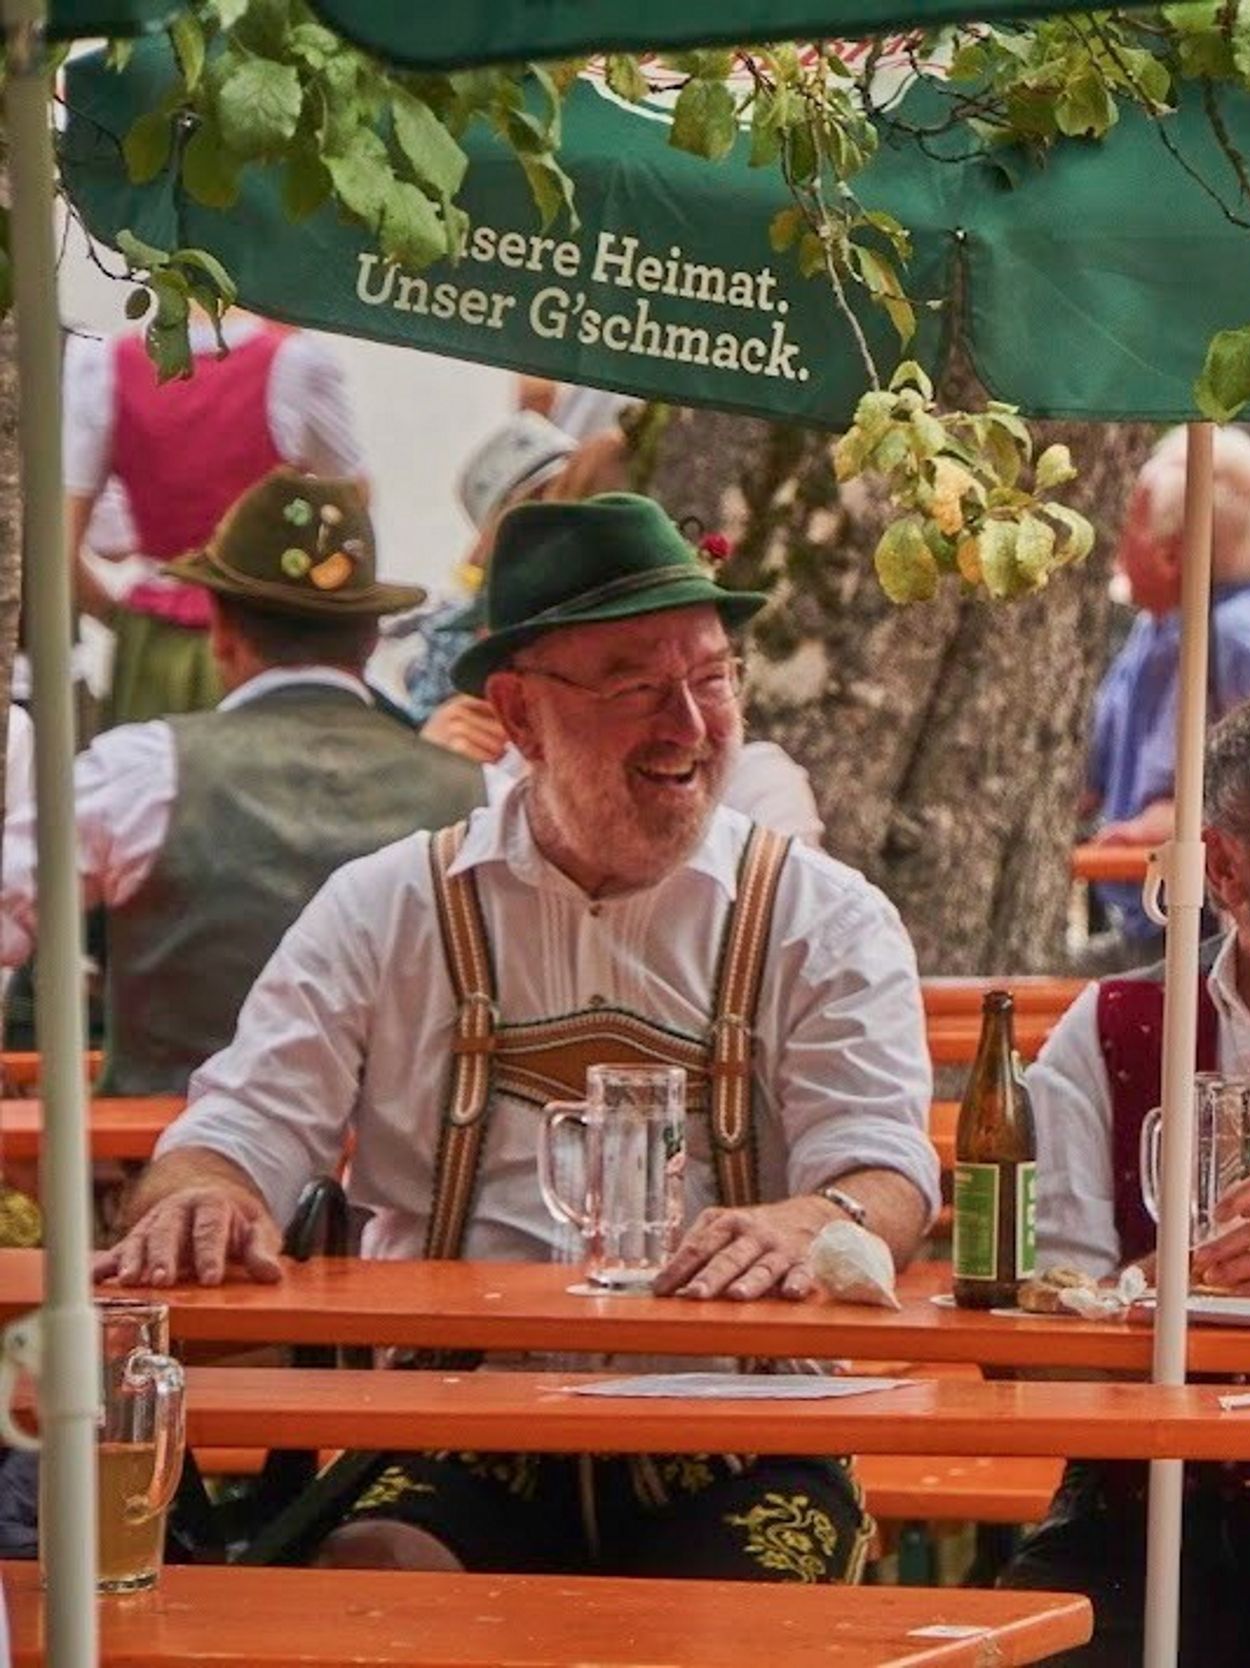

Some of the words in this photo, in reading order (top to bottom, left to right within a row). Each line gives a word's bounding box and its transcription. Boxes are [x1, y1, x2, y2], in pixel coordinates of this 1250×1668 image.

[356, 252, 516, 329] Unser
[458, 222, 581, 277] sere
[592, 231, 790, 315] Heimat.
